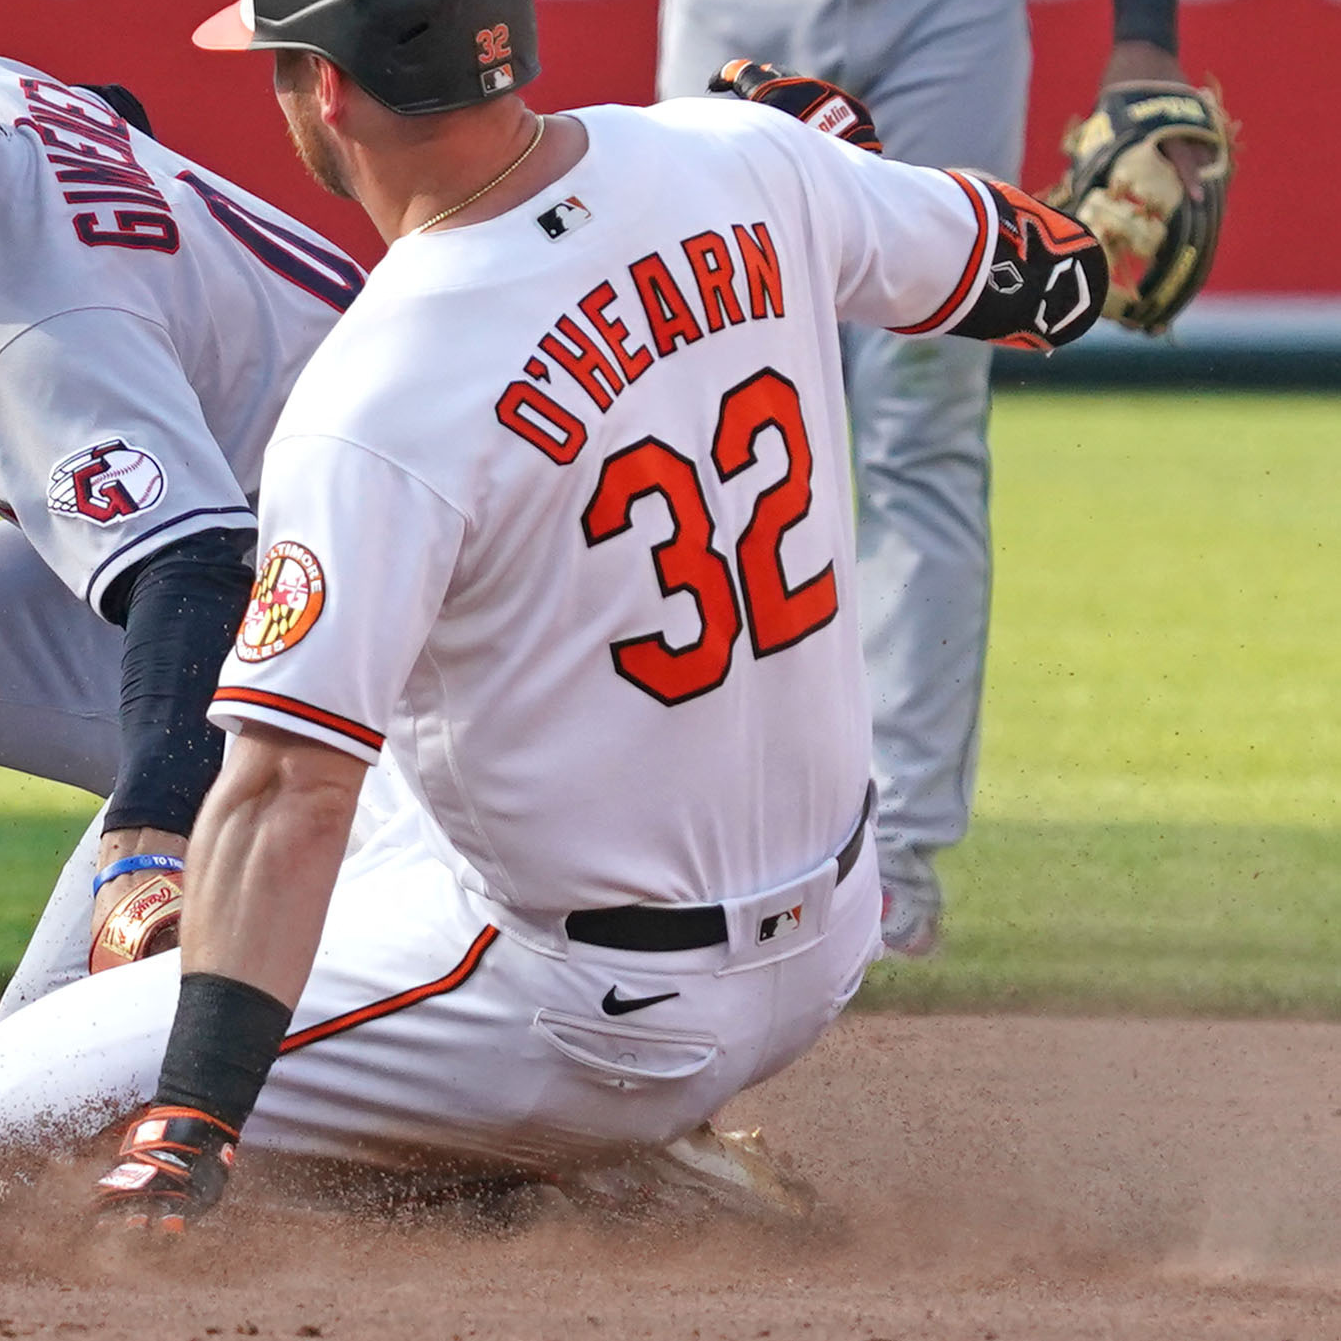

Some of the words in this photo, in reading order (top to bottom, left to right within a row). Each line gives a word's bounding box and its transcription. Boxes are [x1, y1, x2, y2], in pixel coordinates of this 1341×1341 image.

[475, 22, 512, 65] 32
[494, 221, 786, 466] O'HEARN
[257, 543, 322, 593] LTIMORE
[580, 365, 839, 708] 32
